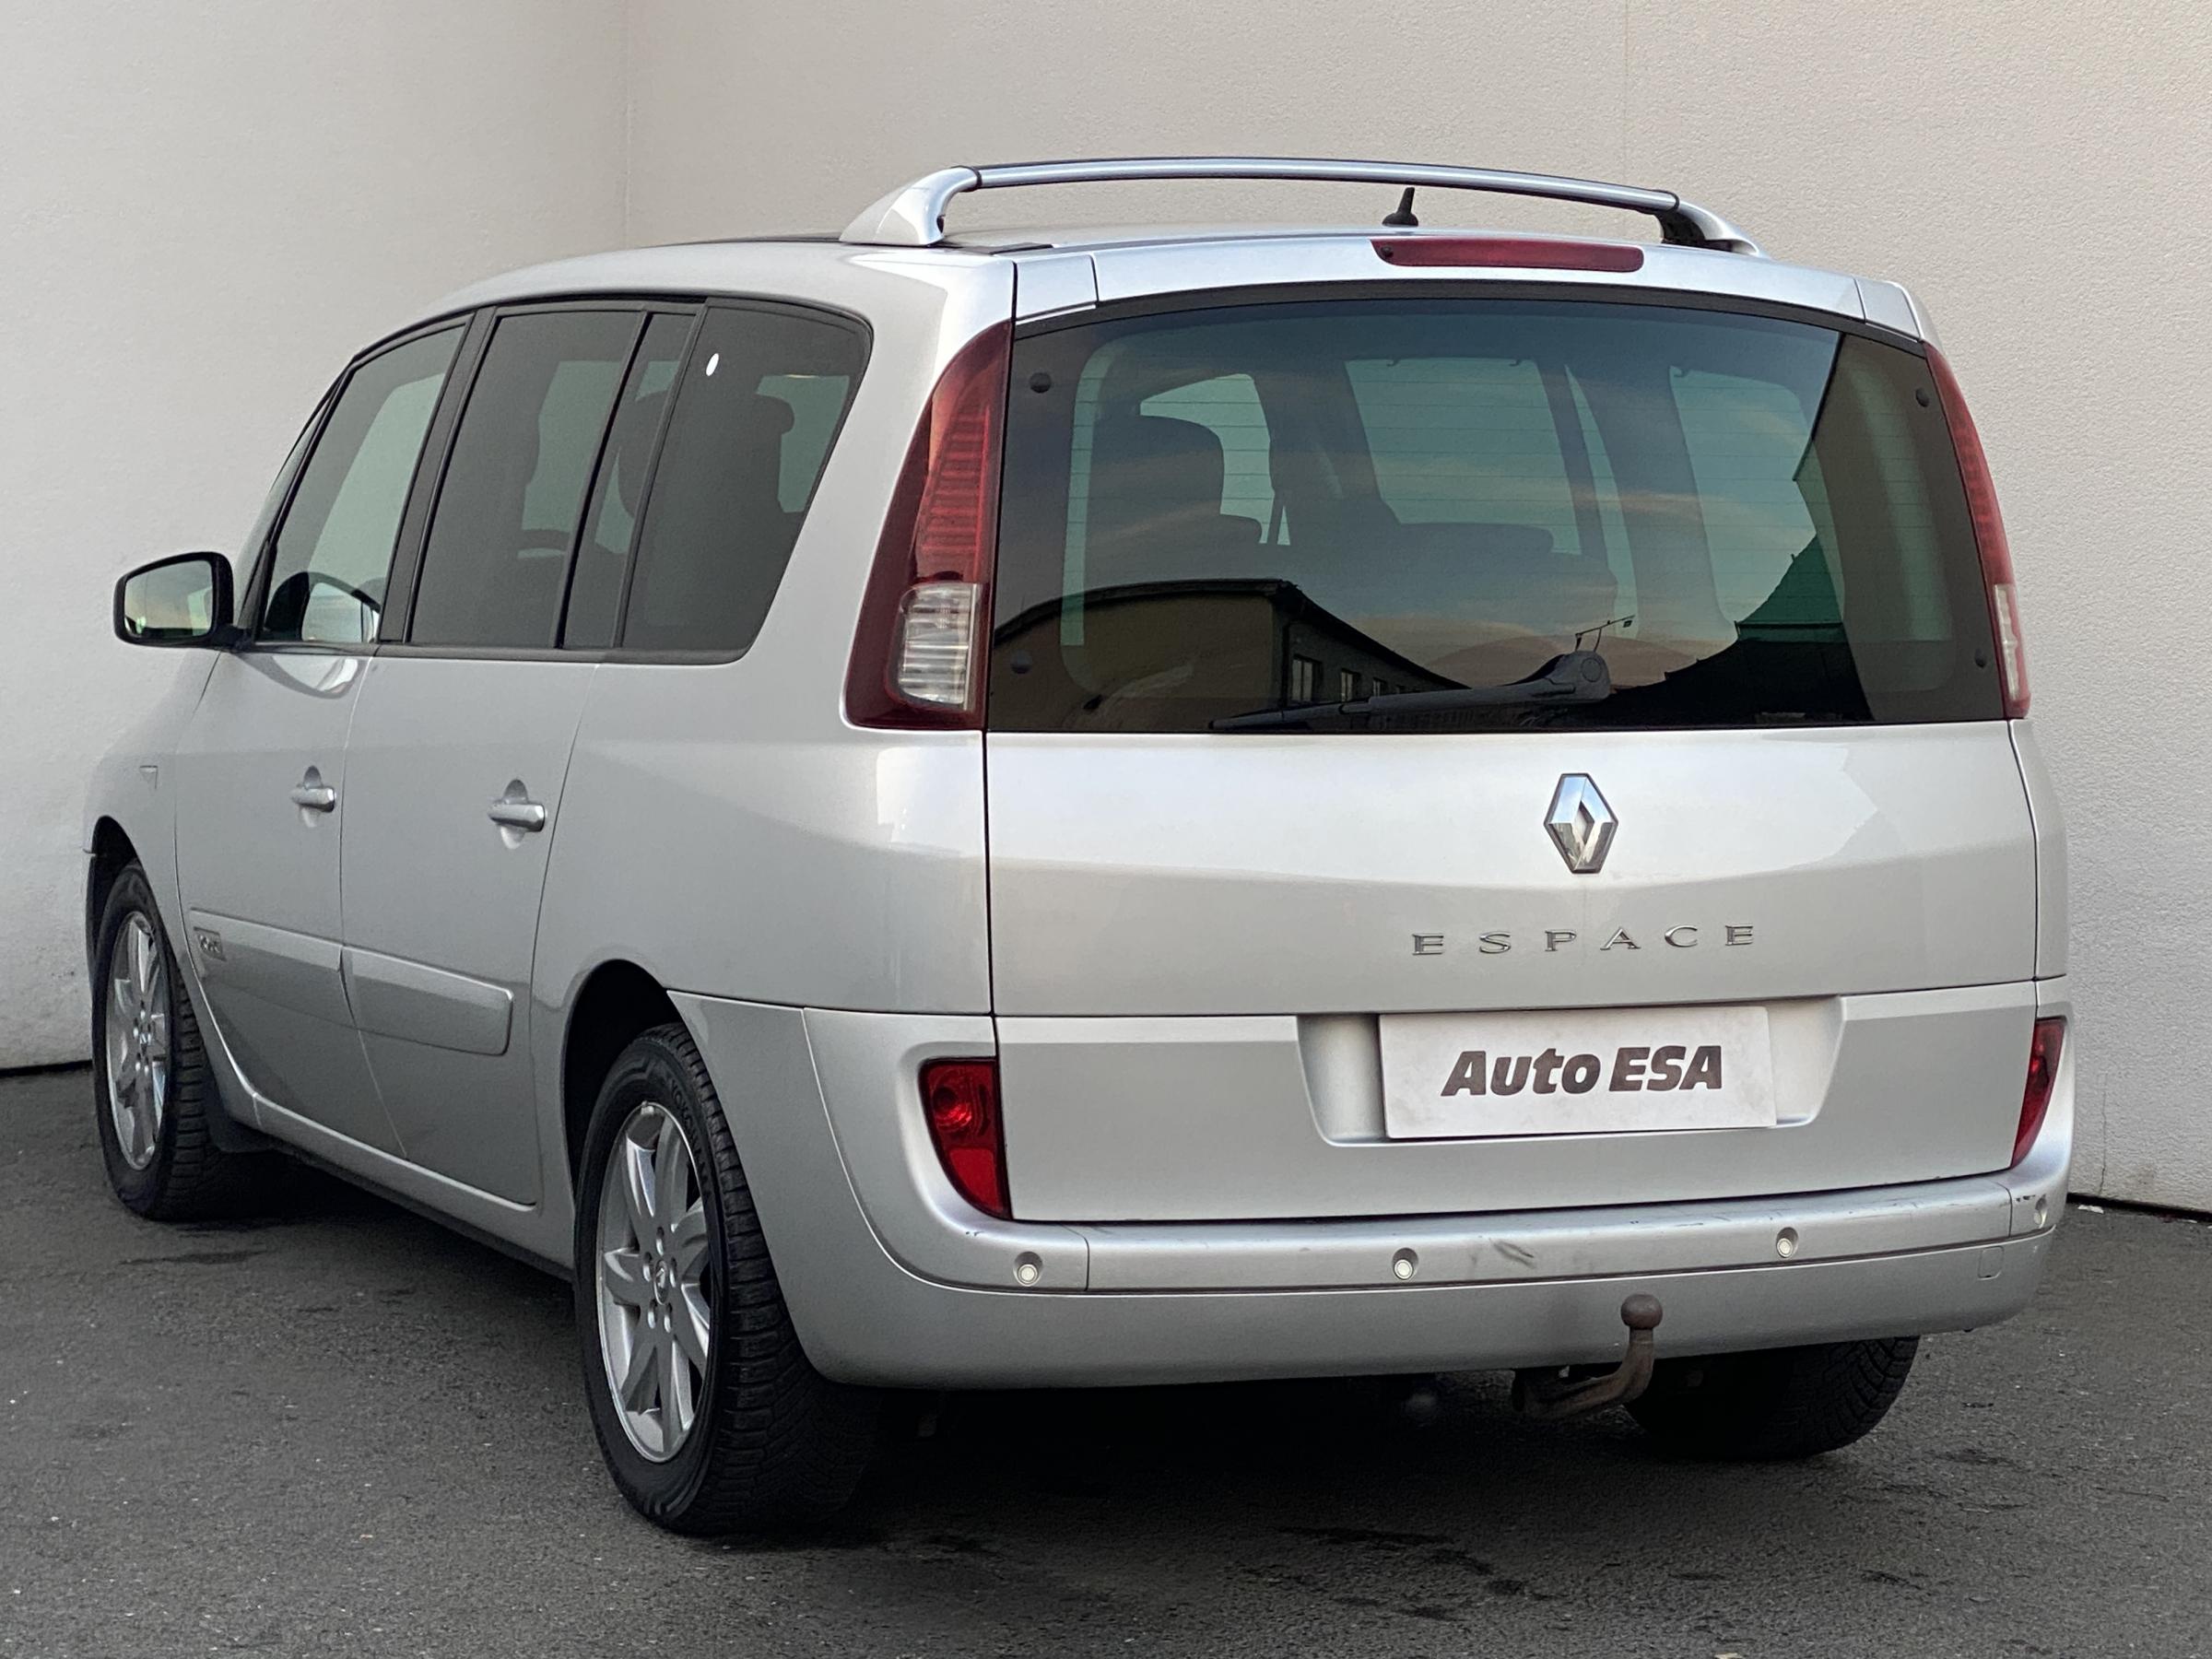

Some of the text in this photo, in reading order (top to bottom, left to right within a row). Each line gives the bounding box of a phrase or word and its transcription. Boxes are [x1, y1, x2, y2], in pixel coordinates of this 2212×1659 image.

[1412, 924, 1753, 955] ESPACE
[1441, 1045, 1722, 1097] Auto ESA
